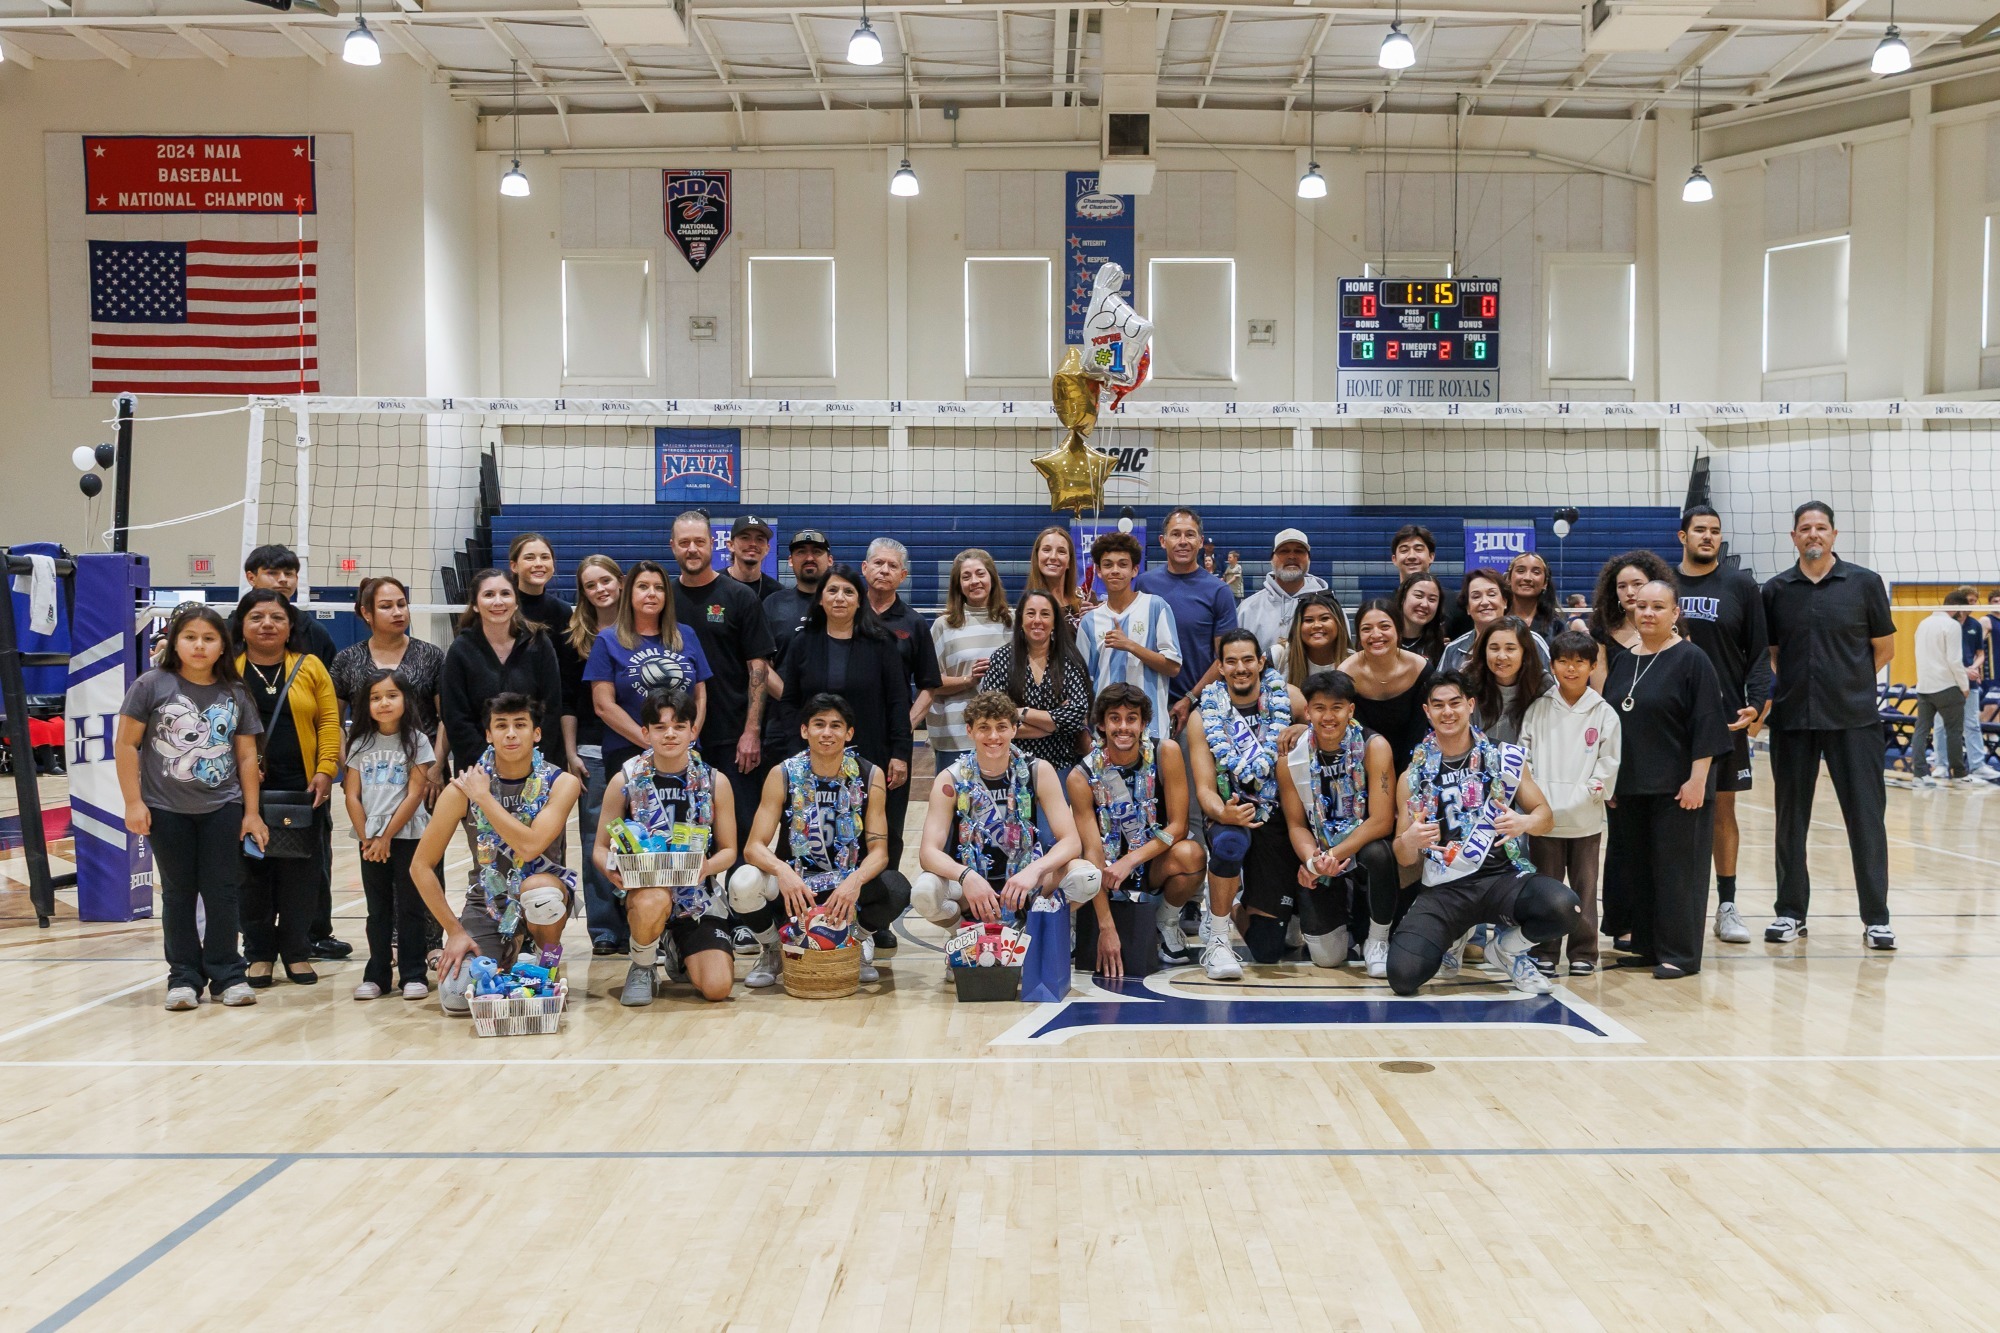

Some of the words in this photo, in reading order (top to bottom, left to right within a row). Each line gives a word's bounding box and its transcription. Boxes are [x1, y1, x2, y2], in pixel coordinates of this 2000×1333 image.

[157, 144, 195, 159] 2024
[204, 144, 241, 159] NAIA
[158, 168, 242, 183] BASEBALL
[667, 178, 728, 204] NDA
[118, 192, 196, 207] NATIONAL
[204, 192, 284, 207] CHAMPION
[1081, 239, 1107, 247] INTEGRITY
[1345, 281, 1375, 292] HOME
[1407, 283, 1453, 304] 1:15
[1460, 282, 1498, 293] VISITOR
[1362, 295, 1376, 317] 0
[1482, 295, 1495, 317] 0
[1355, 320, 1380, 329] BONUS
[1399, 315, 1425, 324] PERIOD
[1458, 320, 1483, 329] BONUS
[1352, 333, 1374, 341] FOULS
[1464, 333, 1487, 341] FOULS
[1362, 342, 1373, 359] 0
[1387, 341, 1398, 359] 2
[1401, 342, 1437, 351] TIMEOUTS
[1439, 341, 1451, 359] 2
[1474, 342, 1486, 359] 0
[1094, 342, 1126, 373] #1
[1410, 350, 1427, 359] LEFT
[1346, 379, 1383, 397] HOME
[1386, 379, 1403, 397] OF
[1408, 379, 1434, 397] THE
[1438, 379, 1491, 398] ROYALS
[377, 401, 406, 410] ROYALS
[489, 401, 518, 411] ROYALS
[602, 401, 631, 411] ROYALS
[714, 402, 743, 412] ROYALS
[826, 402, 854, 412] ROYALS
[938, 403, 966, 413] ROYALS
[1161, 403, 1190, 414] ROYALS
[1272, 404, 1301, 414] ROYALS
[1384, 404, 1412, 415] ROYALS
[1495, 405, 1523, 415] ROYALS
[1605, 405, 1634, 415] ROYALS
[1716, 406, 1744, 415] ROYALS
[1825, 406, 1853, 415] ROYALS
[1935, 406, 1963, 415] ROYALS
[662, 454, 733, 486] NAIA
[1472, 532, 1527, 553] HIU
[195, 560, 209, 571] EXIT
[341, 559, 356, 571] EXIT
[629, 648, 661, 665] FINAL
[663, 649, 686, 662] SET
[1503, 744, 1527, 779] 202
[1441, 767, 1474, 786] ROYAL
[658, 787, 687, 801] OYALS
[816, 790, 837, 803] OYAL
